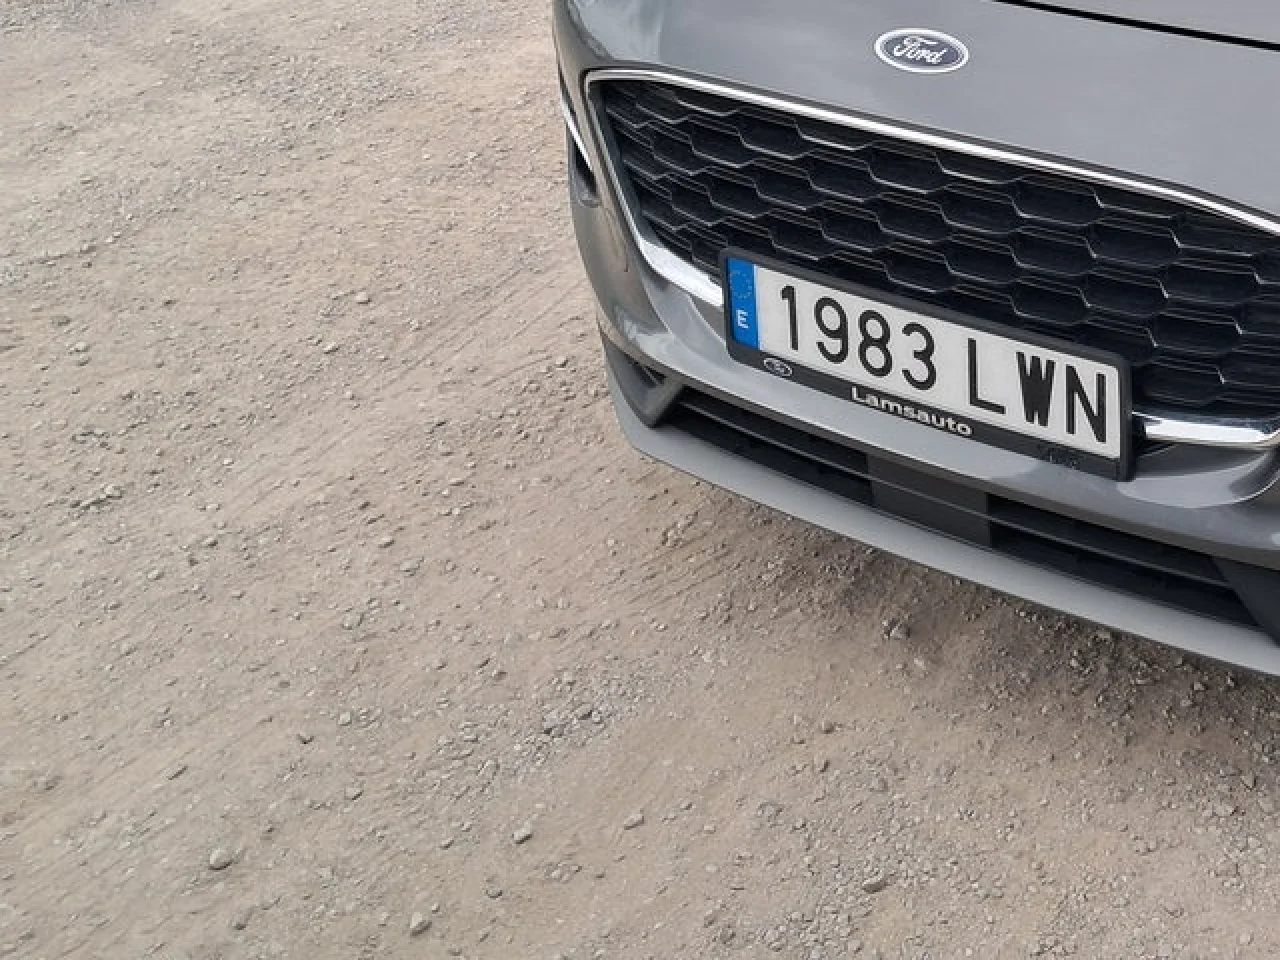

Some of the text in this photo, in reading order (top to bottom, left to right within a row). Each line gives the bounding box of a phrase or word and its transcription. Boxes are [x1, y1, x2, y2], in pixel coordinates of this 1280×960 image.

[892, 35, 948, 64] Ford
[737, 308, 749, 329] E
[780, 284, 1107, 443] 1983 LWN
[851, 384, 973, 437] Lamsauto
